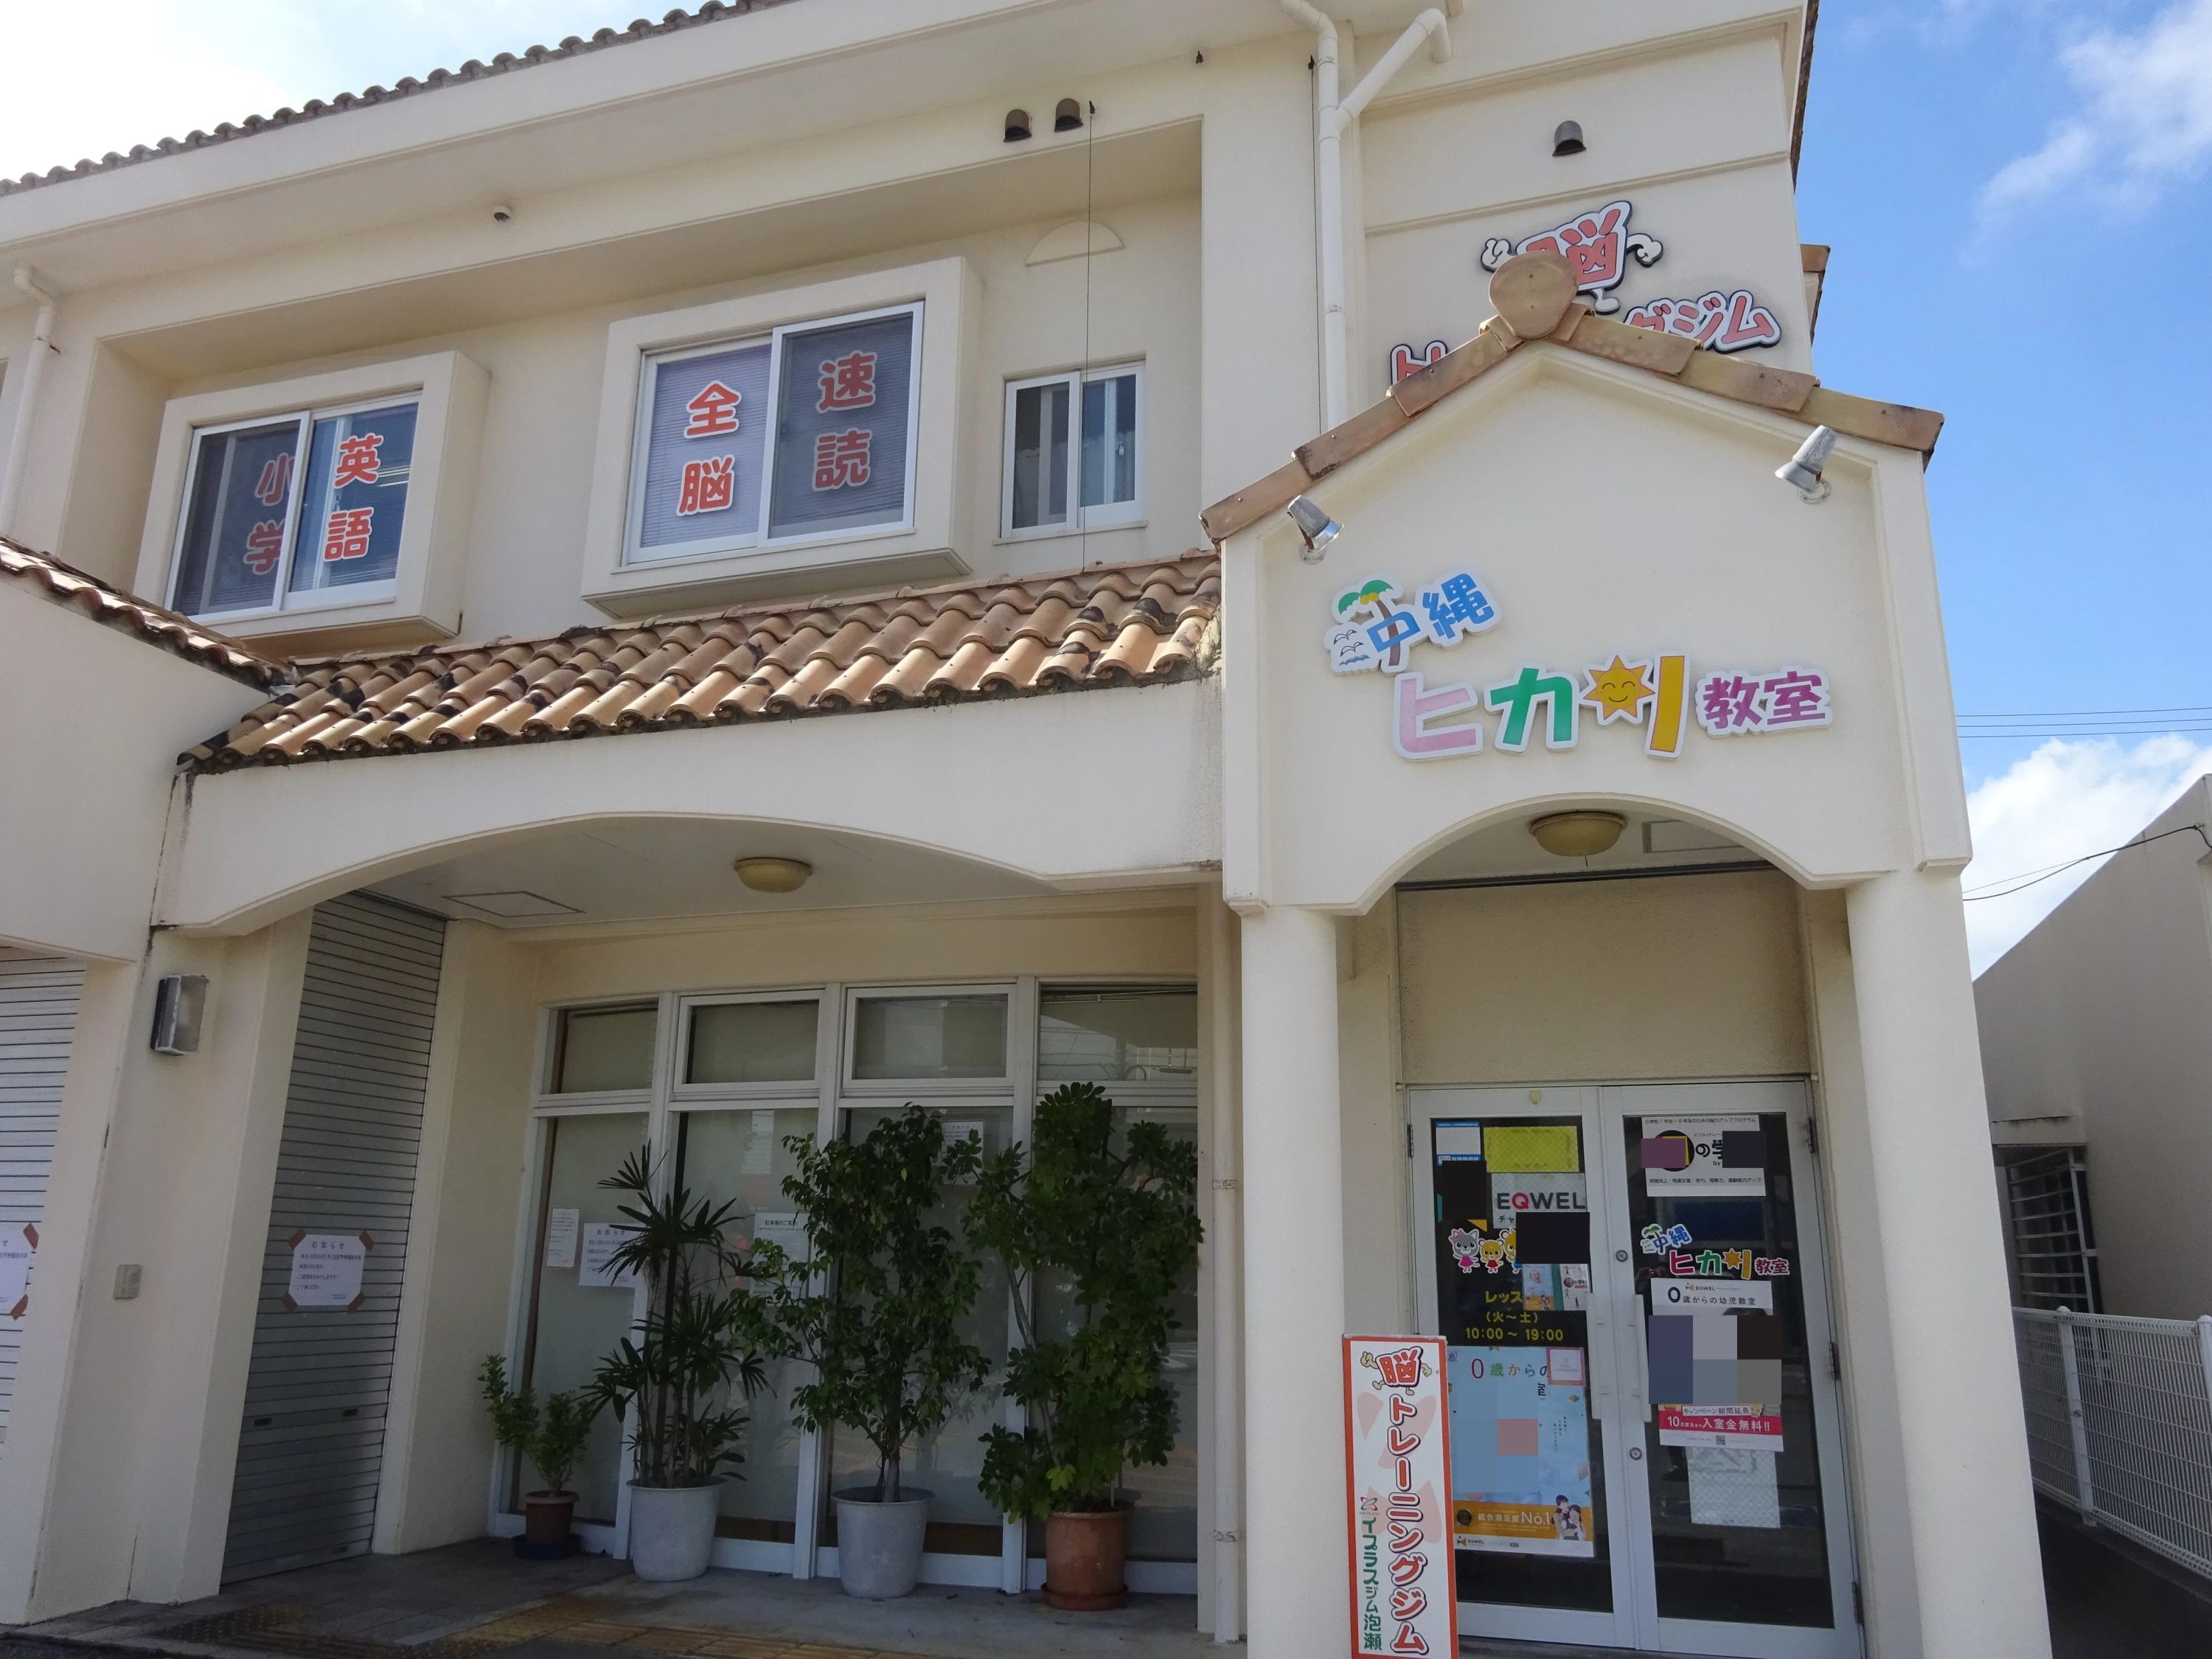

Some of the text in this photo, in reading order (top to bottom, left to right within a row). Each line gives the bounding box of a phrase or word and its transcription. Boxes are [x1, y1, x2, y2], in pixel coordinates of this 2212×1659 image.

[676, 381, 742, 516] 全脳
[813, 350, 877, 492] 速読
[323, 433, 383, 562] 英語
[1325, 572, 1501, 675] 沖縄
[1497, 1192, 1585, 1210] EQWEL
[1375, 1346, 1430, 1655] 脳トレーニングジム
